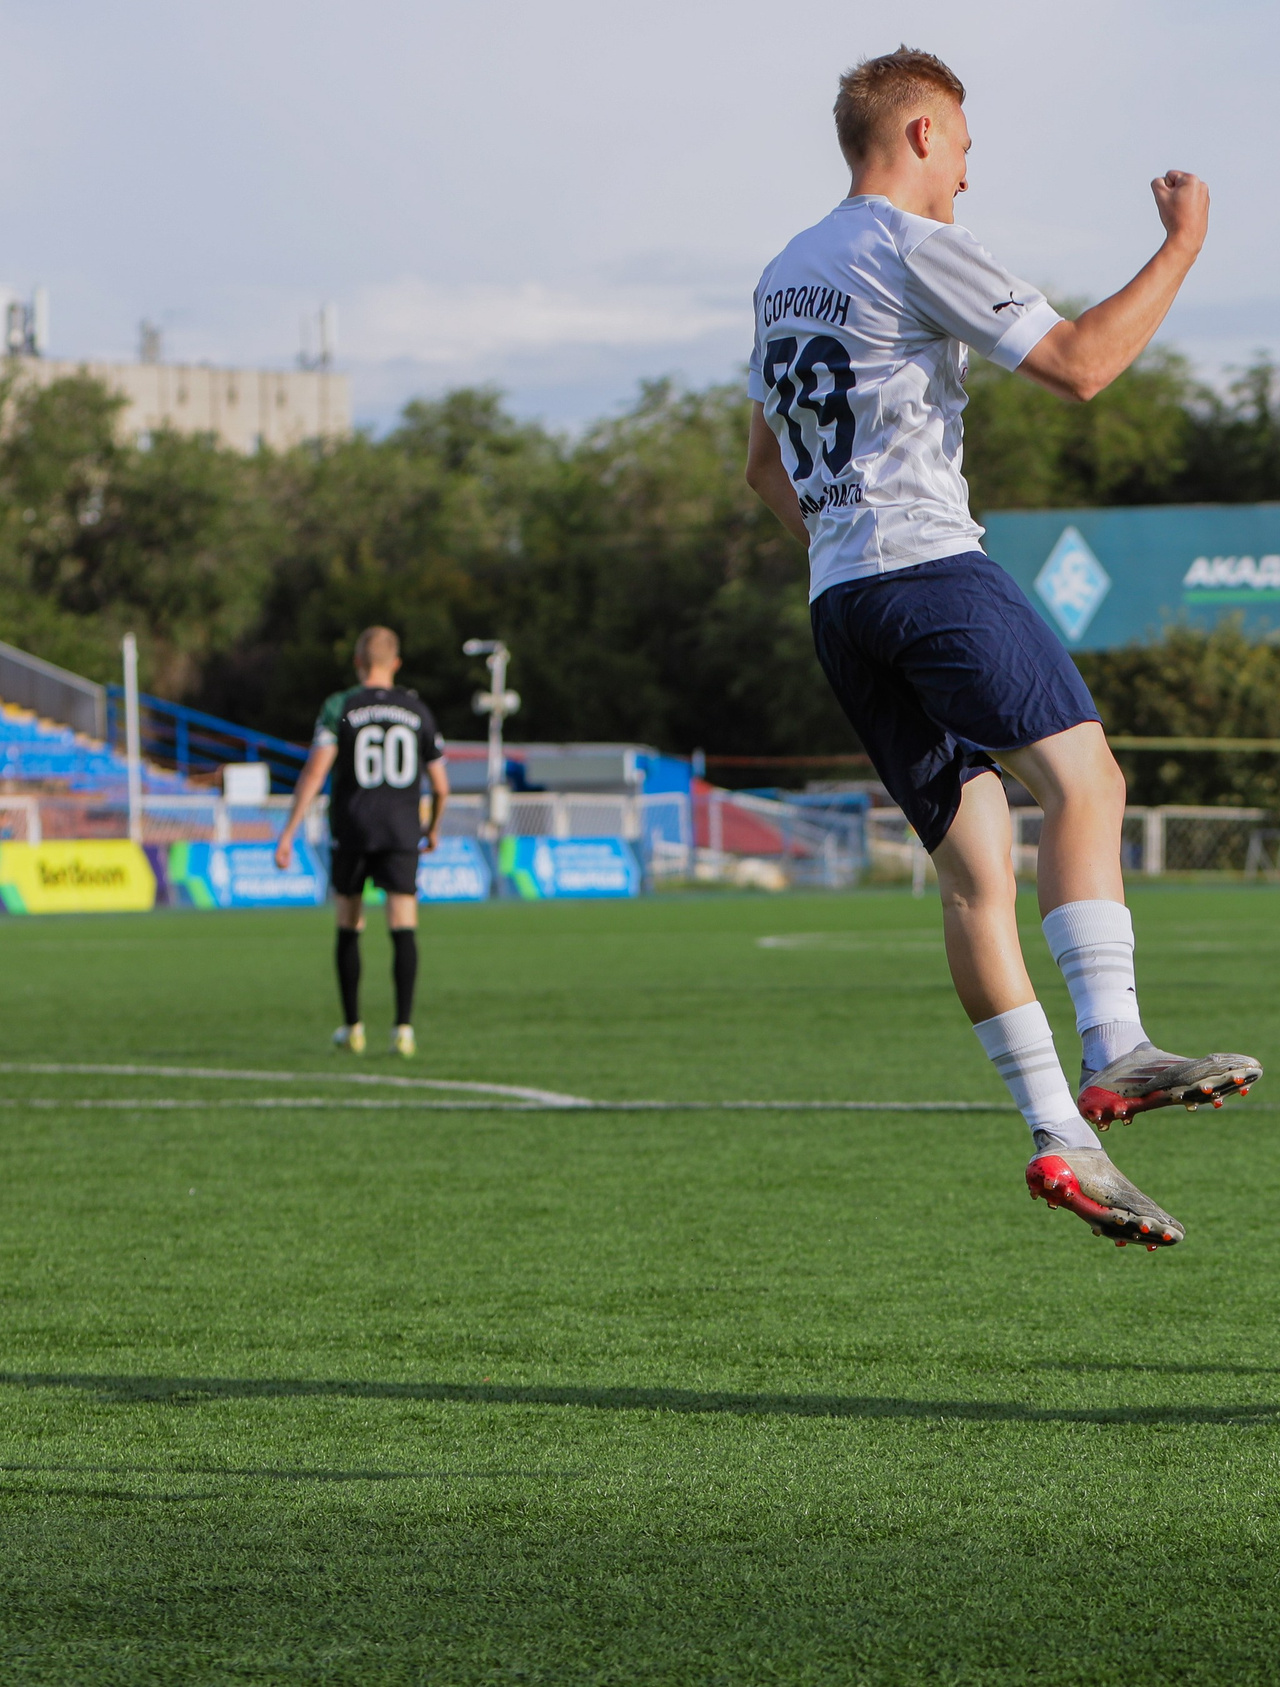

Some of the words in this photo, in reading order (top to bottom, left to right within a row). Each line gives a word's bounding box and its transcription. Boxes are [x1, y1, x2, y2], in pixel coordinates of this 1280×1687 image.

[763, 285, 851, 327] СОРОКИН
[763, 335, 856, 482] 79
[354, 724, 418, 789] 60
